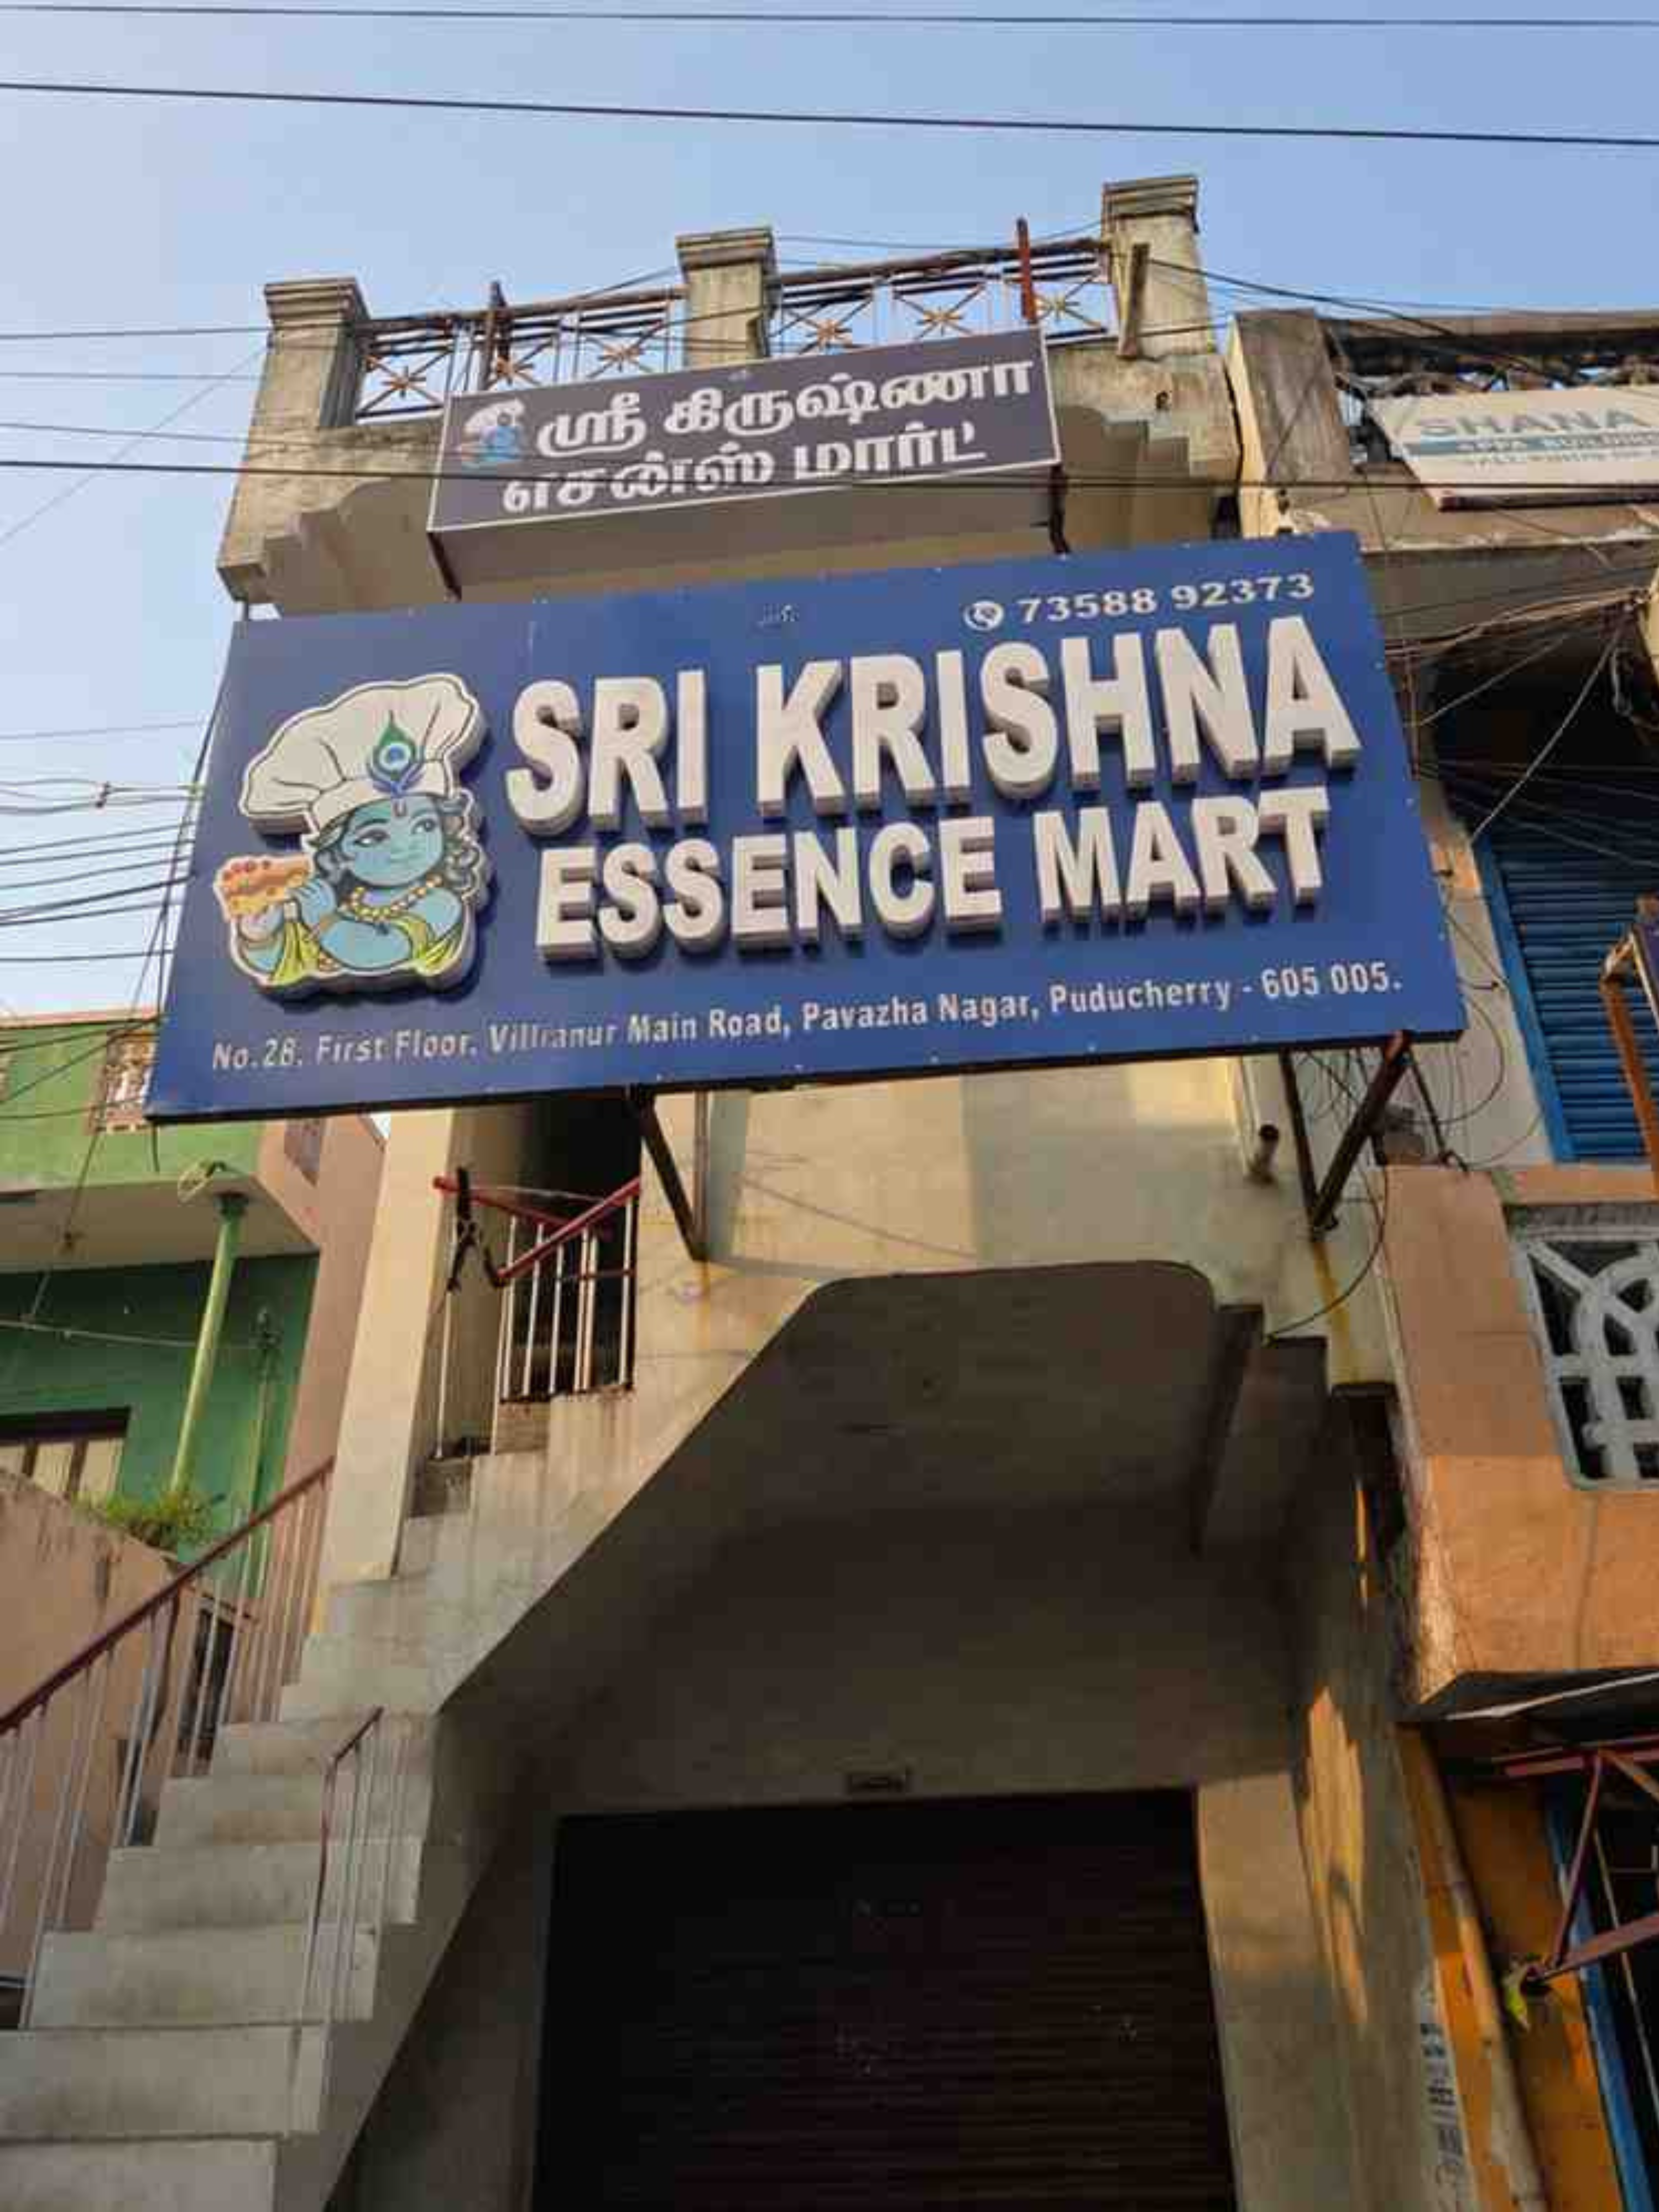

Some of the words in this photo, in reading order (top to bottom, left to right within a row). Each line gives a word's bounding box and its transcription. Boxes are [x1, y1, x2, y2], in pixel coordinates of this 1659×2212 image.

[664, 361, 1034, 437] கிருஷ்ணா
[794, 421, 986, 480] மார்ட்
[1018, 587, 1157, 623] 73588
[1171, 573, 1314, 609] 92373
[506, 669, 708, 835] SRI
[754, 616, 1361, 816] KRISHNA
[535, 816, 1001, 961] ESSENCE
[1033, 786, 1331, 924] MART
[316, 1035, 385, 1065] First
[627, 1013, 696, 1044] Main
[709, 1004, 791, 1040] Road,
[802, 996, 928, 1031] Pavazha
[938, 993, 1040, 1028] Nagar,
[1050, 978, 1231, 1013] Puducherry
[1261, 966, 1320, 1000] 605
[1329, 961, 1404, 995] 005.
